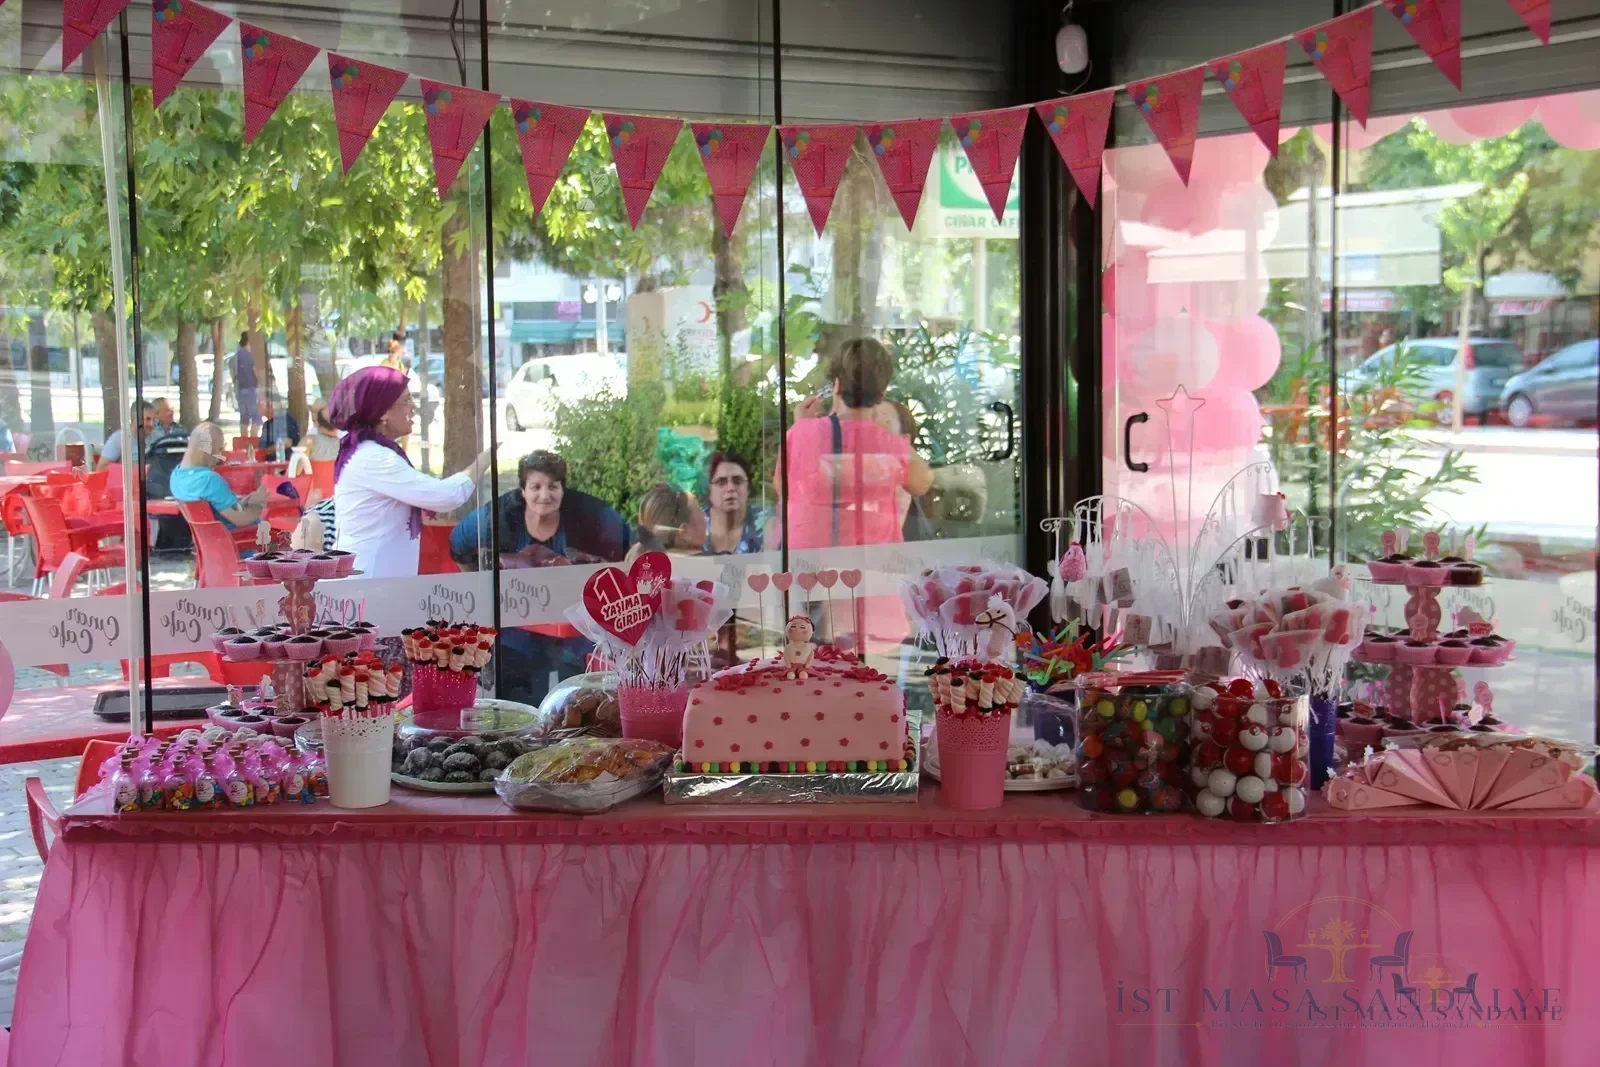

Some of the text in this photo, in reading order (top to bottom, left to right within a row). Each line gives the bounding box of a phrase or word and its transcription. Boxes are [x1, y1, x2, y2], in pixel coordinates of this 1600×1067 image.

[336, 82, 371, 138] 1
[433, 106, 466, 161] 1
[525, 123, 559, 179] 1
[619, 144, 656, 199] 1
[714, 142, 747, 197] 1
[804, 144, 836, 198] 1
[888, 139, 923, 194] 1
[976, 130, 1012, 186] 1
[593, 568, 624, 604] 1
[602, 593, 641, 619] YAŞIMA
